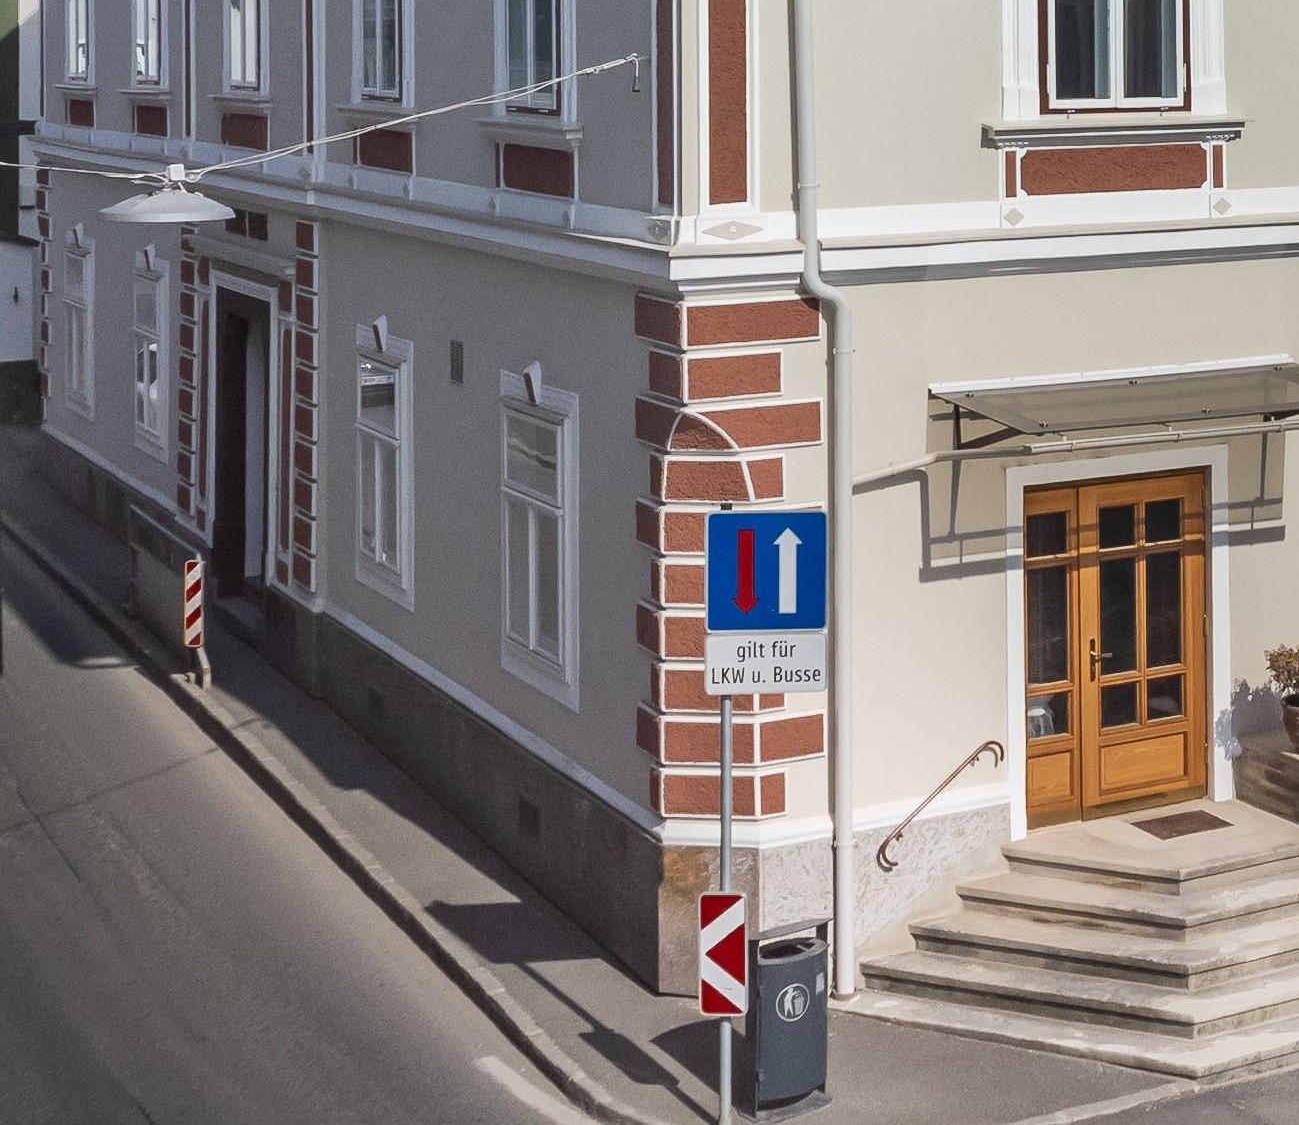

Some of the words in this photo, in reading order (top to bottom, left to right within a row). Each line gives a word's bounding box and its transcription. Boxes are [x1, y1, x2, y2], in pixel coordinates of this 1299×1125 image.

[737, 641, 765, 662] gilt
[772, 641, 796, 658] für
[711, 667, 745, 684] LKW
[752, 670, 766, 683] u.
[773, 666, 821, 682] Busse
